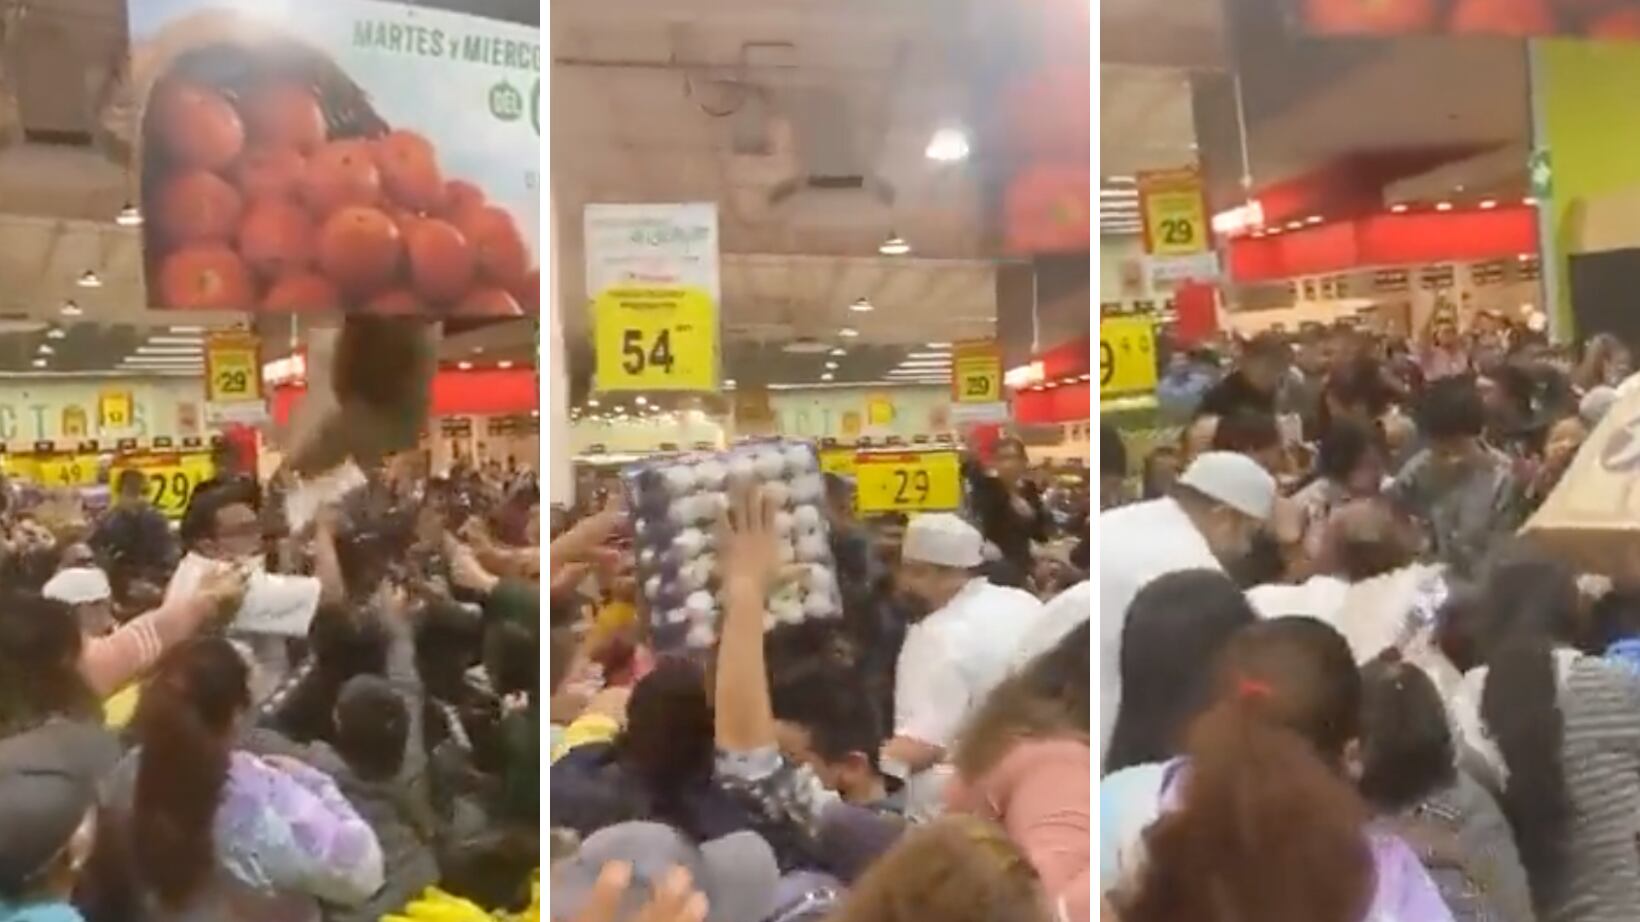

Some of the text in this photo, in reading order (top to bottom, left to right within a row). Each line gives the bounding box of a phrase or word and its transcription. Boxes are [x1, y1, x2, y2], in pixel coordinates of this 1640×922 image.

[353, 20, 445, 57] MARTES
[1161, 219, 1193, 244] 29
[622, 328, 674, 375] 54
[220, 370, 246, 393] 29
[58, 464, 82, 485] 49
[151, 472, 190, 510] 29
[893, 469, 931, 504] 29
